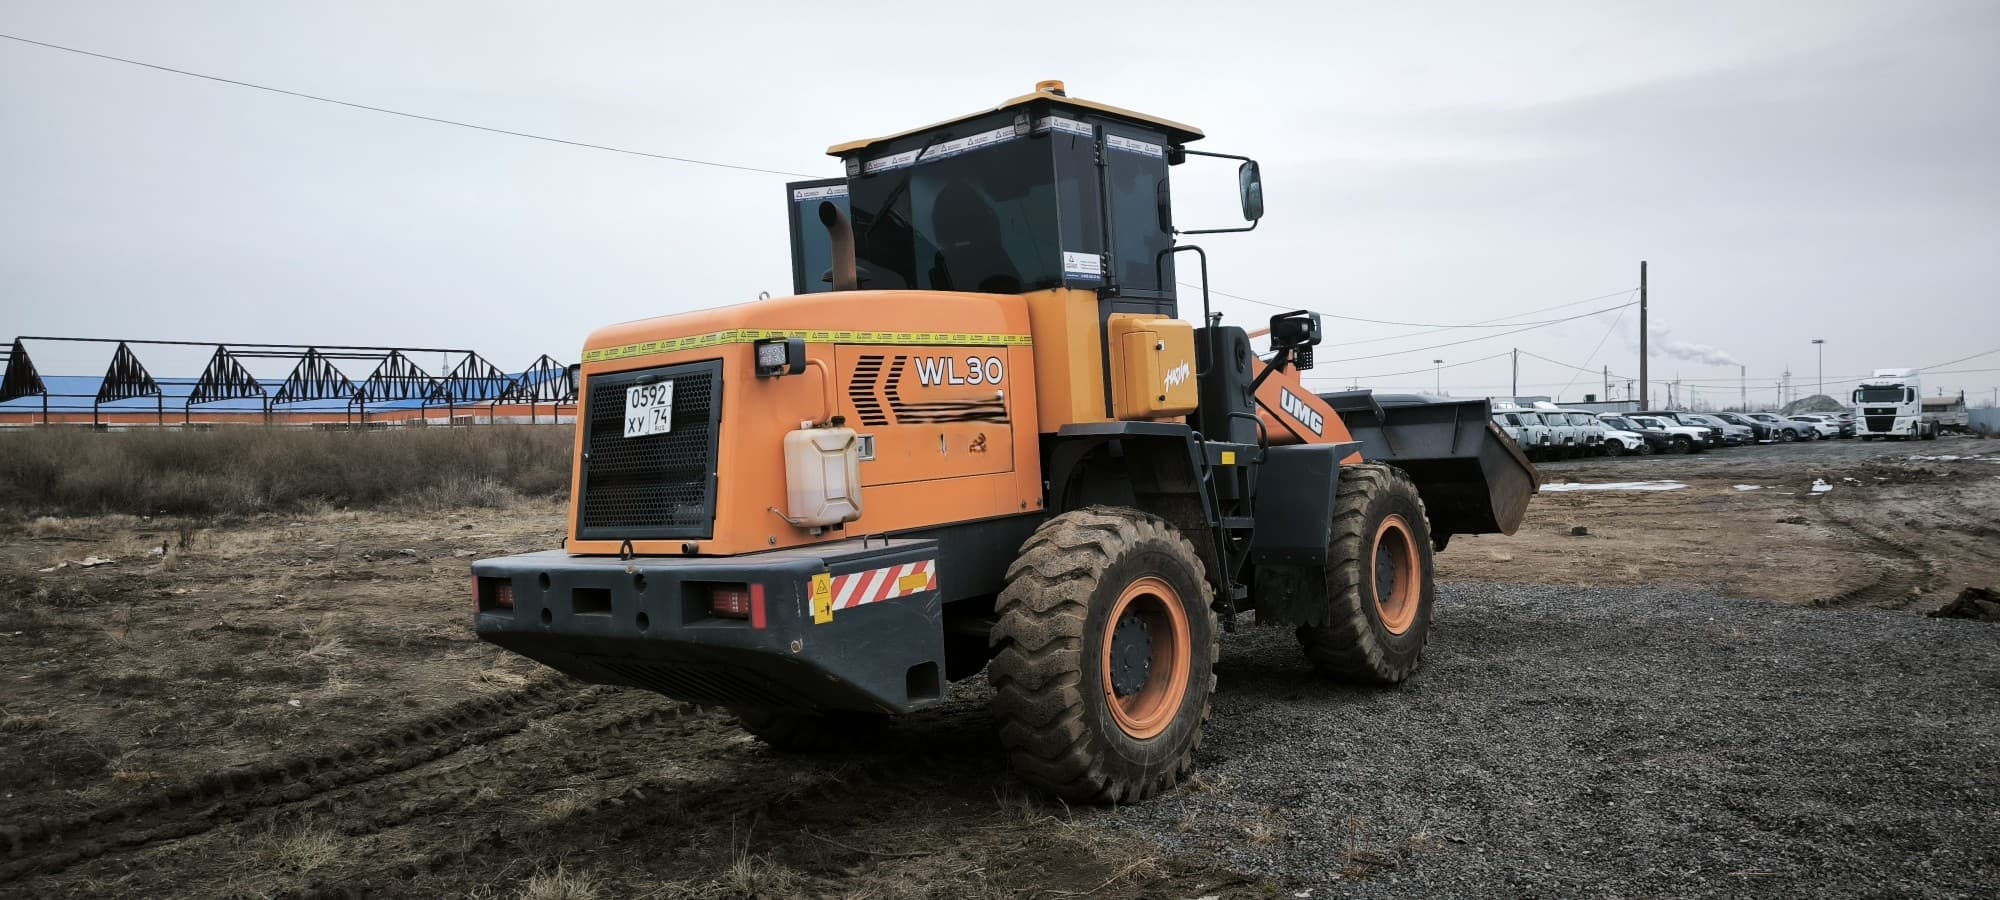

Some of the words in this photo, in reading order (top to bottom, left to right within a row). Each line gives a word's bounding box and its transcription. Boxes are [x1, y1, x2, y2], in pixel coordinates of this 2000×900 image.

[914, 356, 1003, 386] WL30
[631, 384, 666, 408] 0592
[654, 408, 667, 425] 74
[1281, 387, 1323, 437] UMG
